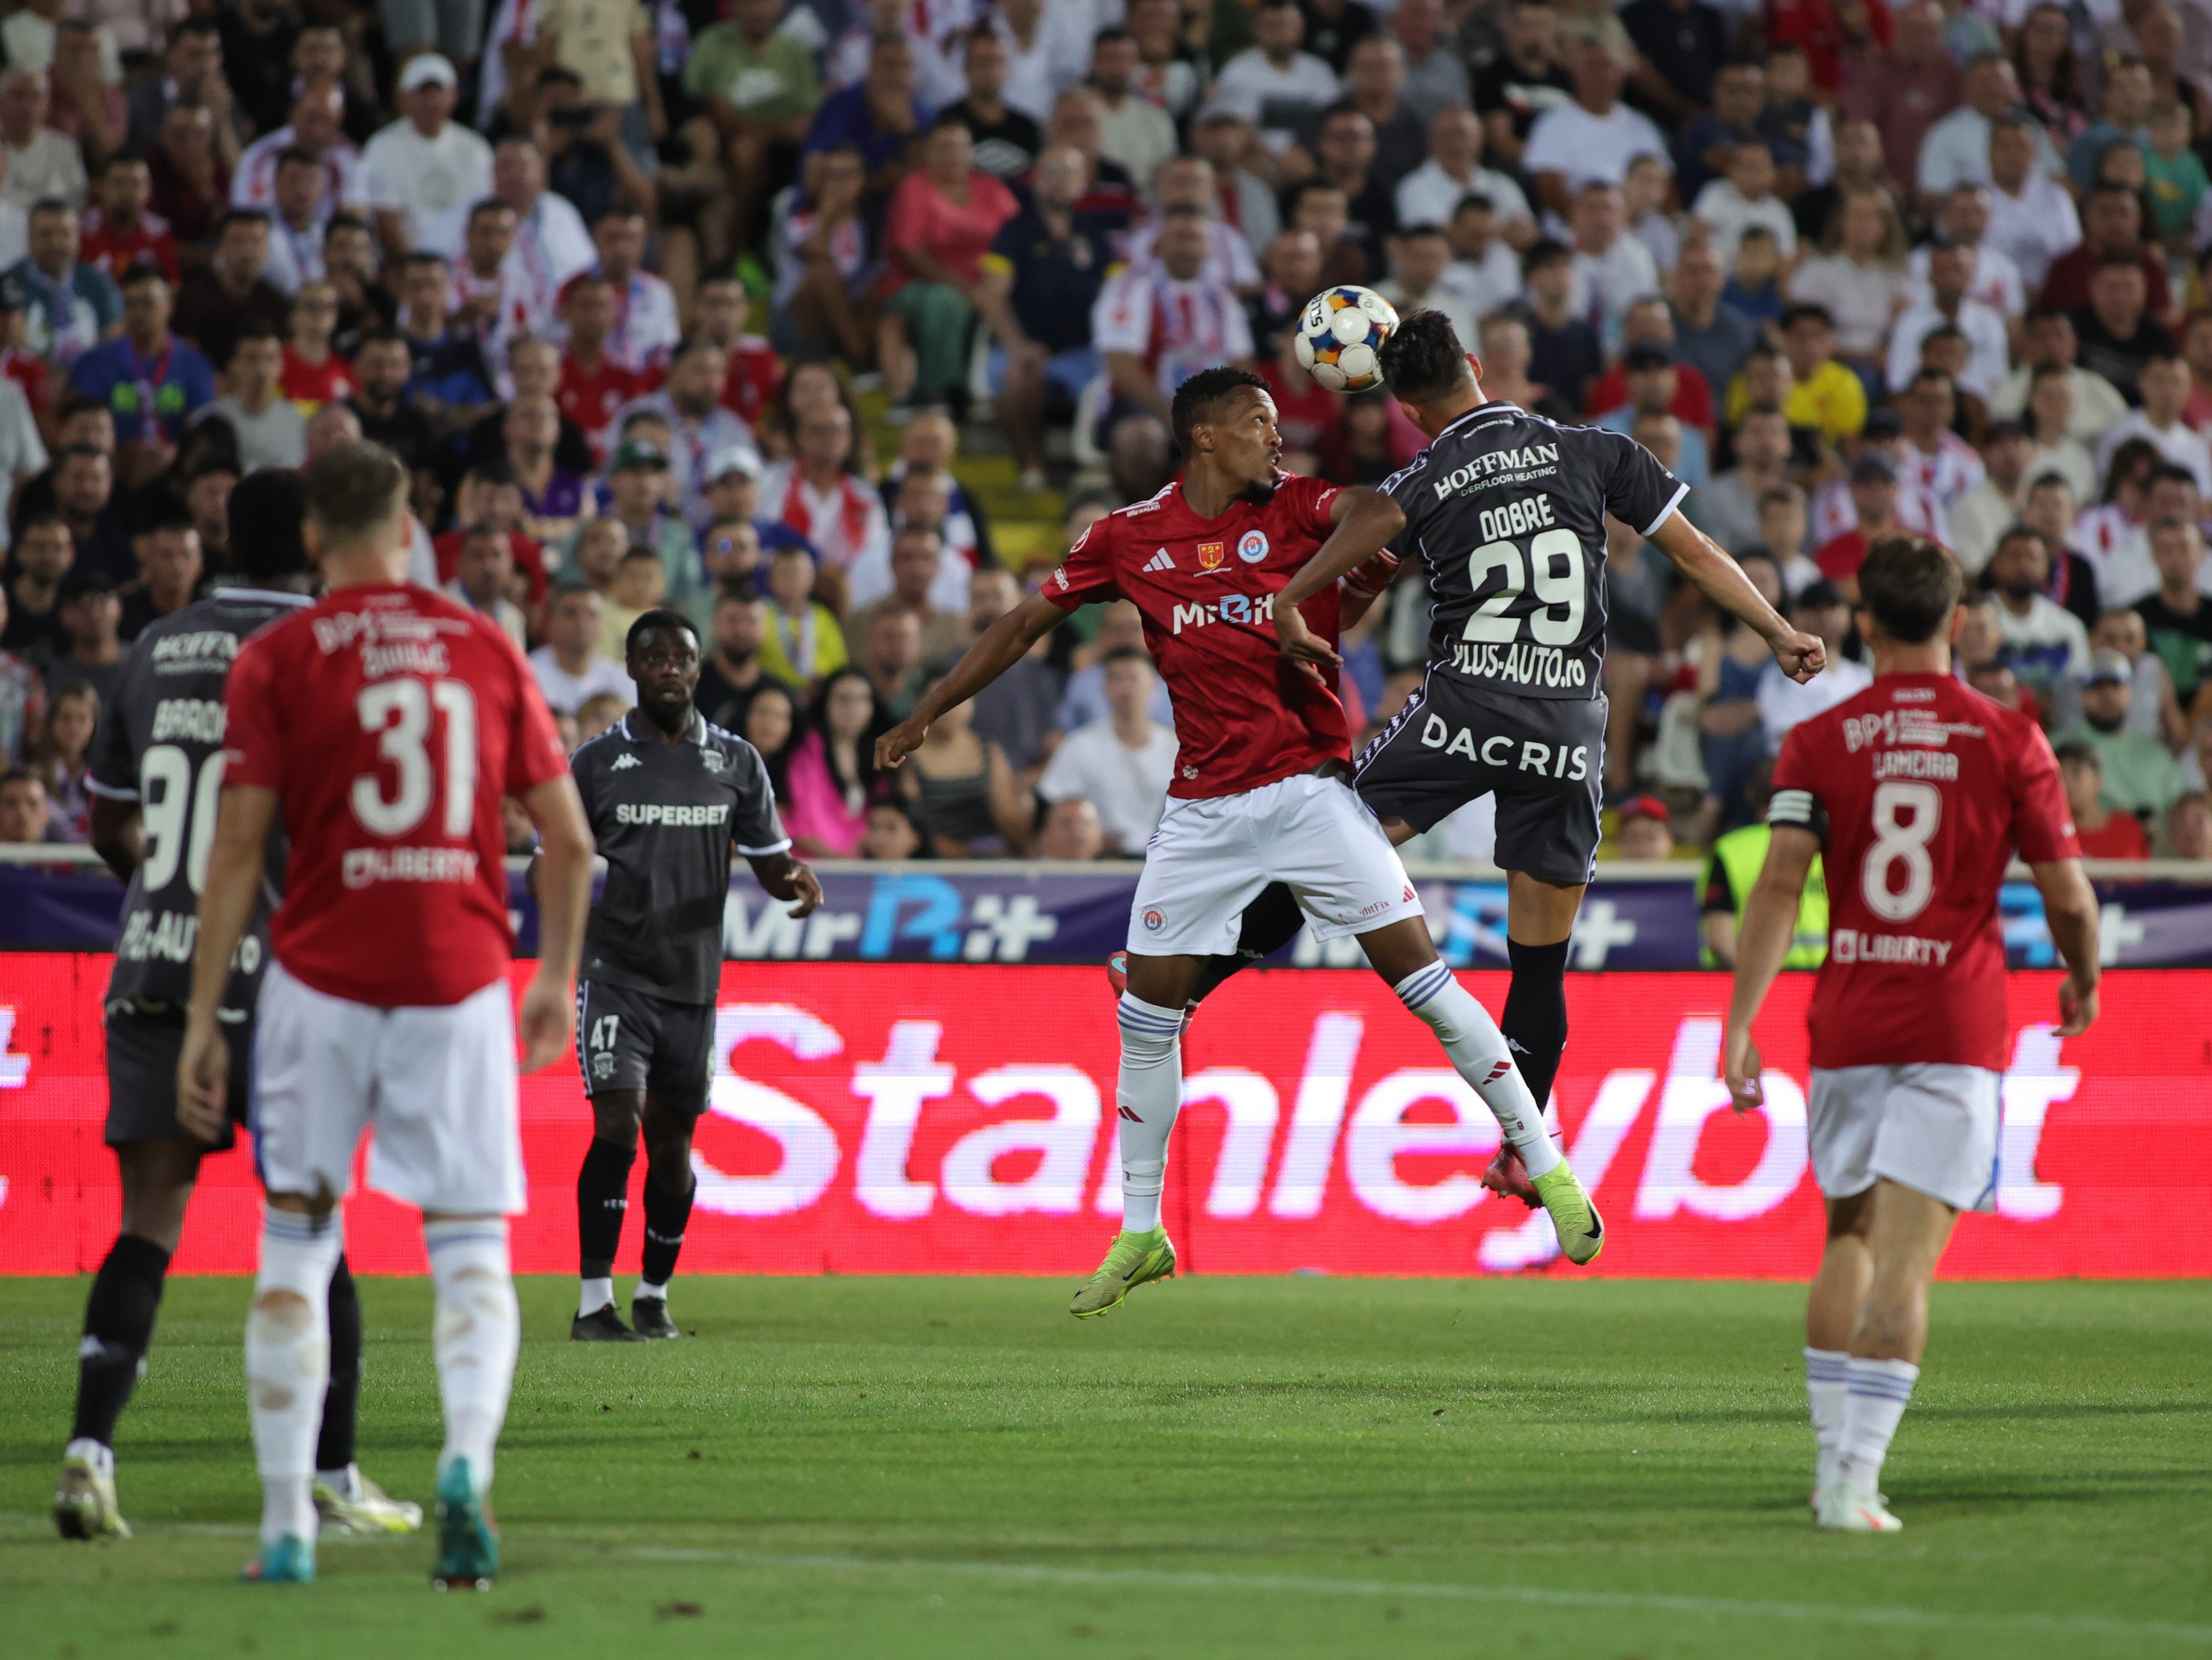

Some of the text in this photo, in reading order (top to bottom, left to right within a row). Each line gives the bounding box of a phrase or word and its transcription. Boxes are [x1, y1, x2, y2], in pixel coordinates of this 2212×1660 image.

[1433, 443, 1559, 500] HOFFMAN
[1514, 466, 1557, 481] HEATING
[1479, 493, 1555, 543] DOBRE
[1462, 528, 1585, 645] 29
[1173, 593, 1275, 635] MrBit
[350, 677, 478, 837] 31
[1421, 713, 1587, 781] DACRIS
[616, 803, 729, 826] SUPERBET
[1861, 780, 1941, 921] 8
[1860, 934, 1952, 966] LIBERTY
[590, 1015, 619, 1051] 47
